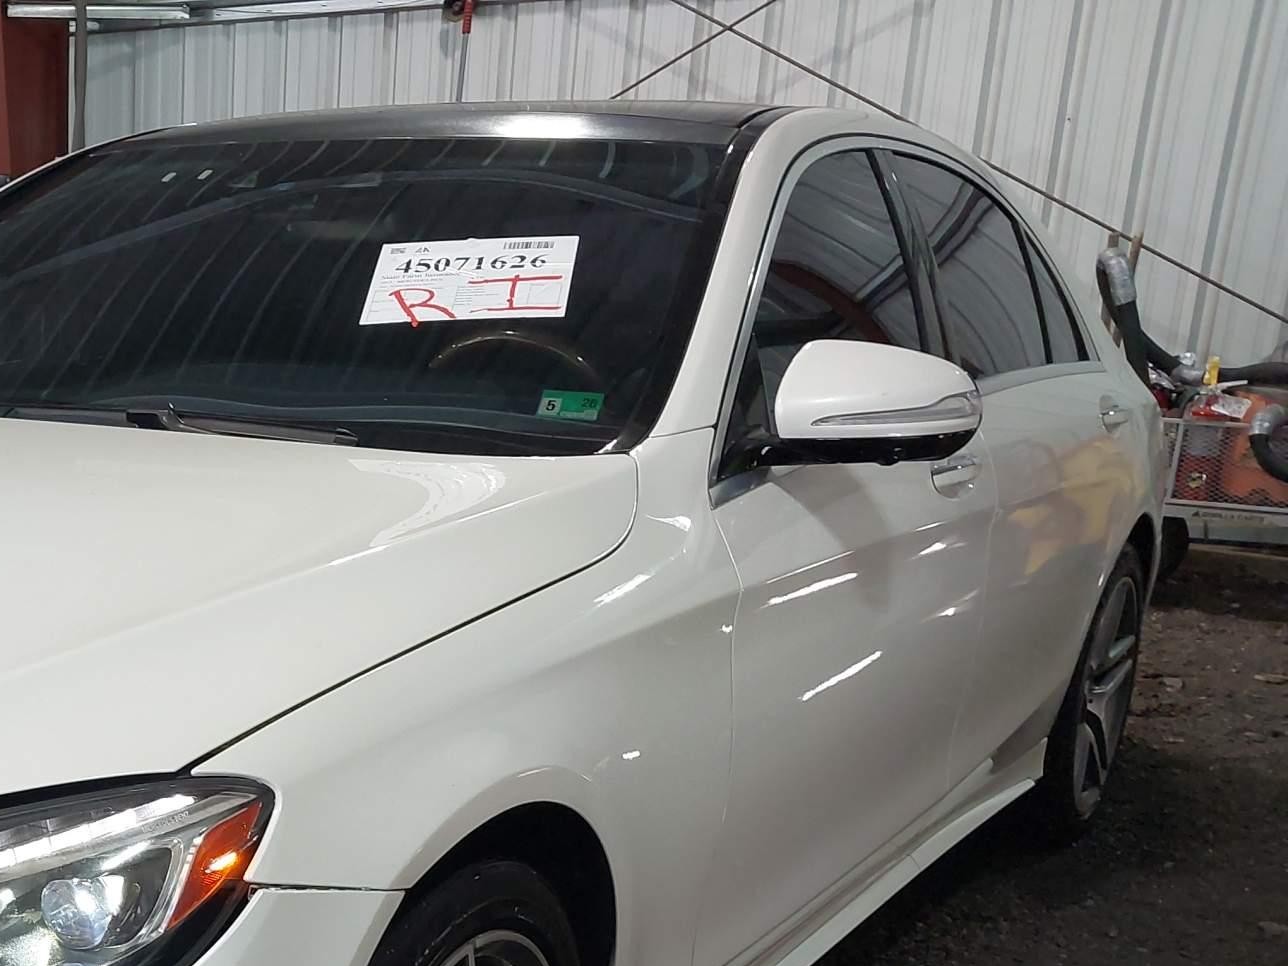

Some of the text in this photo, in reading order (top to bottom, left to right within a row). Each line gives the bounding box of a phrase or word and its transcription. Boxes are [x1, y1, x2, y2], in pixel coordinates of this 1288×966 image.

[395, 253, 549, 273] 45071626
[388, 287, 456, 327] R
[468, 273, 563, 314] I
[545, 399, 557, 411] 5
